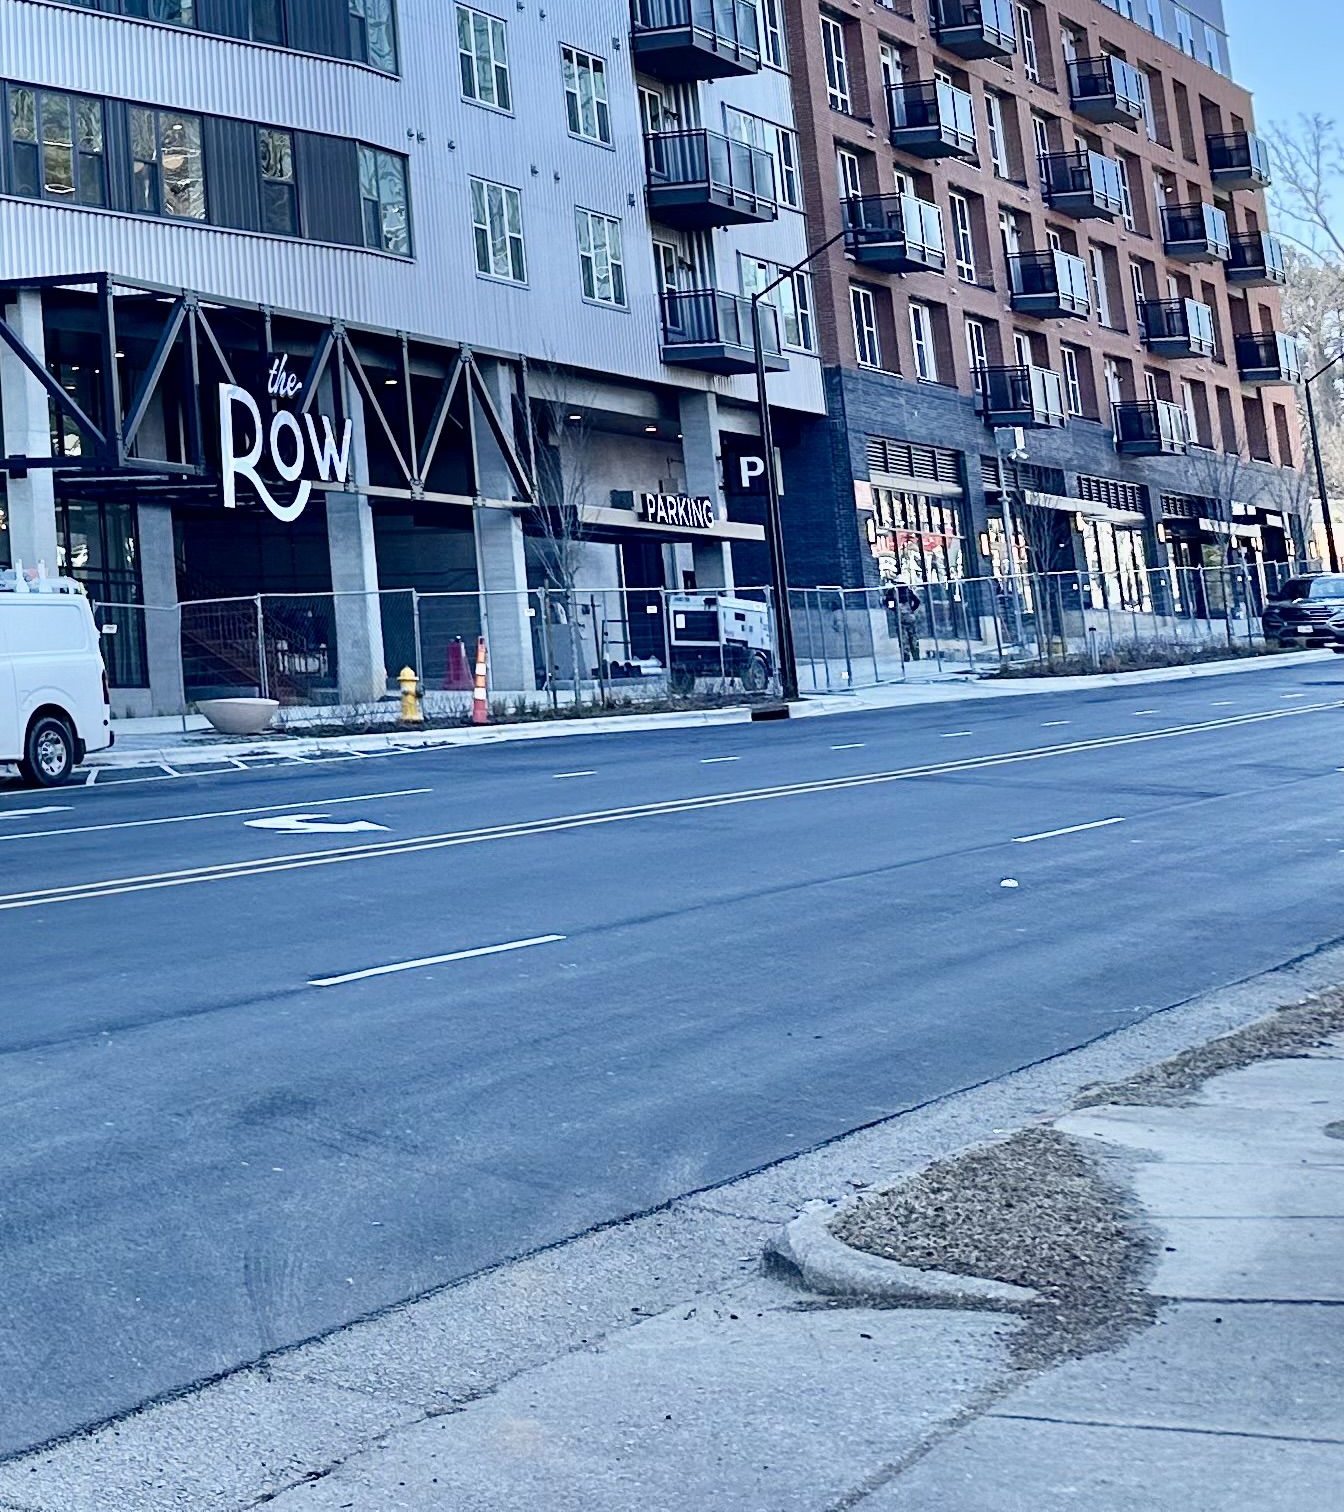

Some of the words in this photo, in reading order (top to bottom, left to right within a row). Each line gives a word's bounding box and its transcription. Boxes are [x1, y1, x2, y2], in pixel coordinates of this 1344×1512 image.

[267, 353, 303, 398] the
[740, 456, 765, 488] P
[646, 493, 715, 529] PARKING
